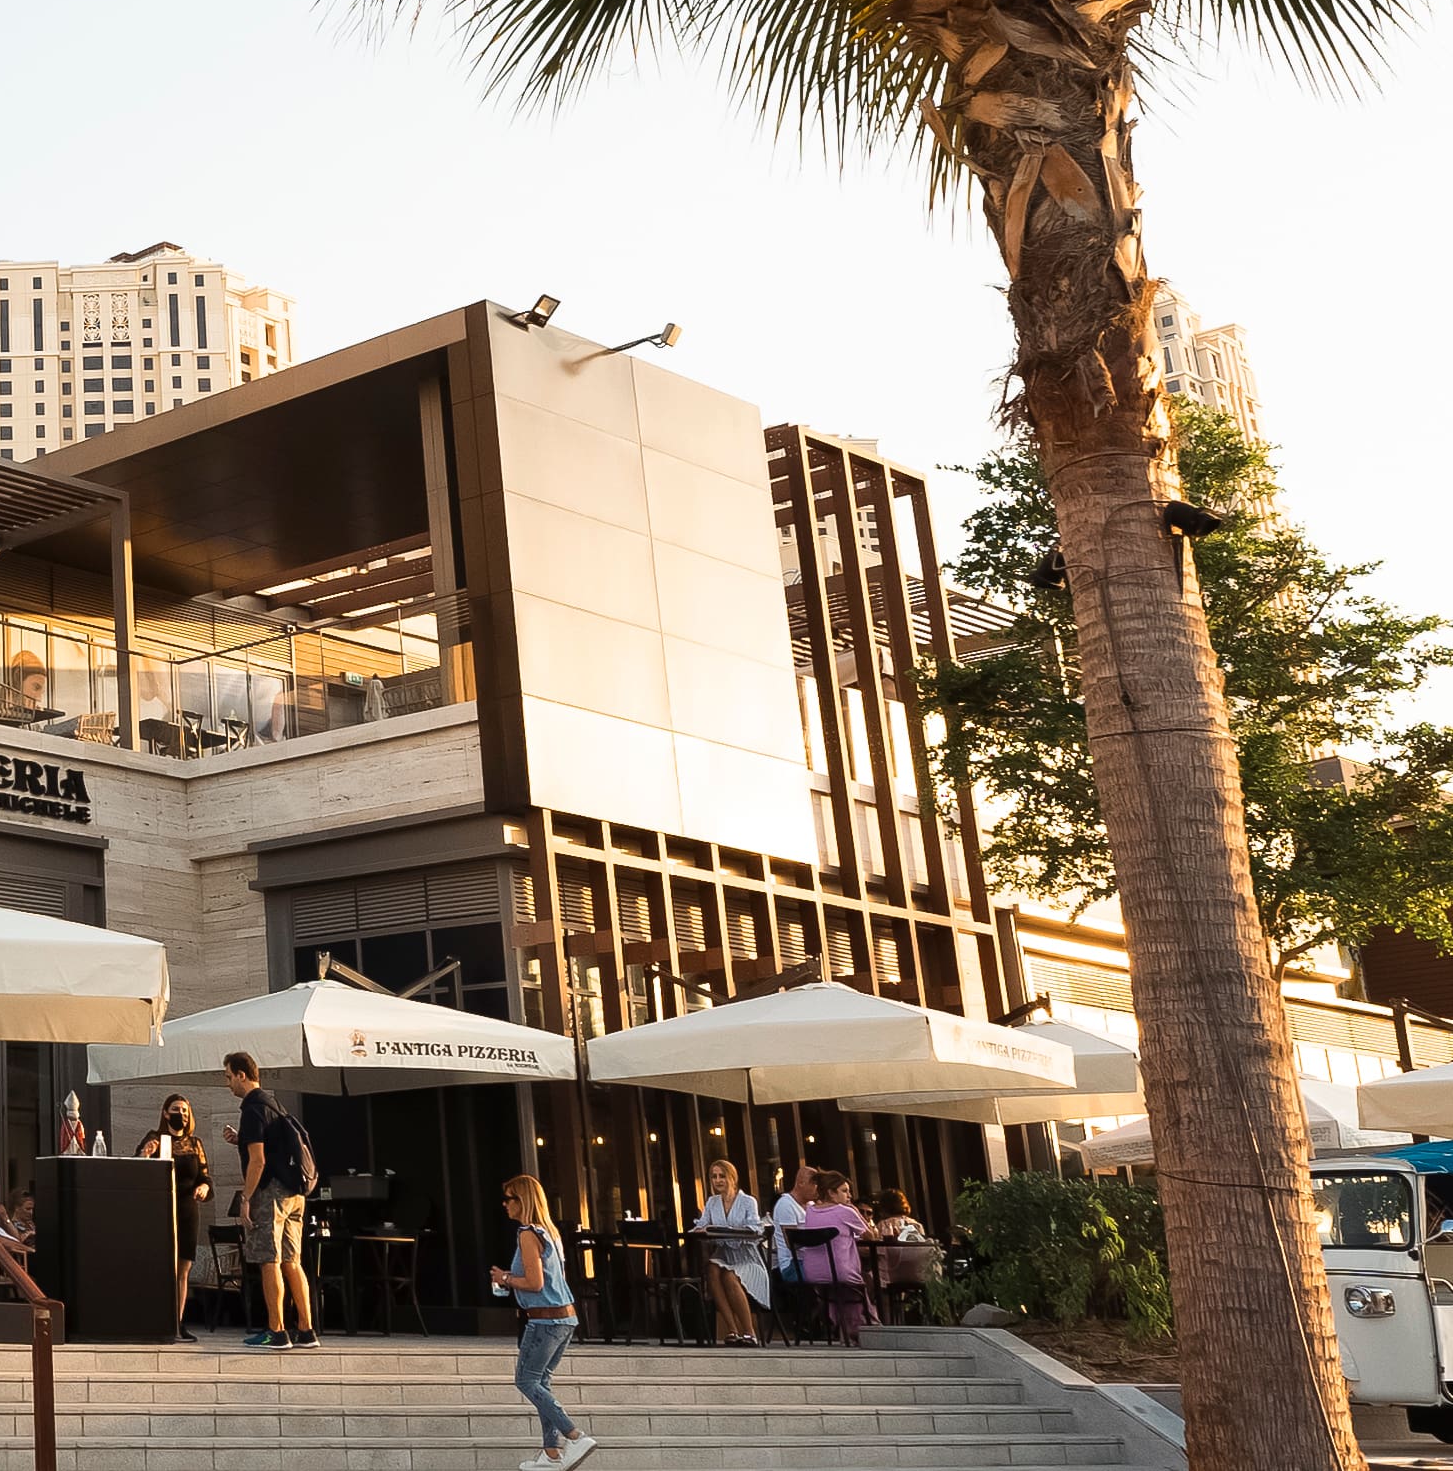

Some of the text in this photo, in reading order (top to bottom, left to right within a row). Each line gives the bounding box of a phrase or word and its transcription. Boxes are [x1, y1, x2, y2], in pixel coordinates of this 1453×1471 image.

[375, 1041, 539, 1064] L'ANTICA PIZZERIA
[969, 1039, 1053, 1067] ANTICA PIZZ
